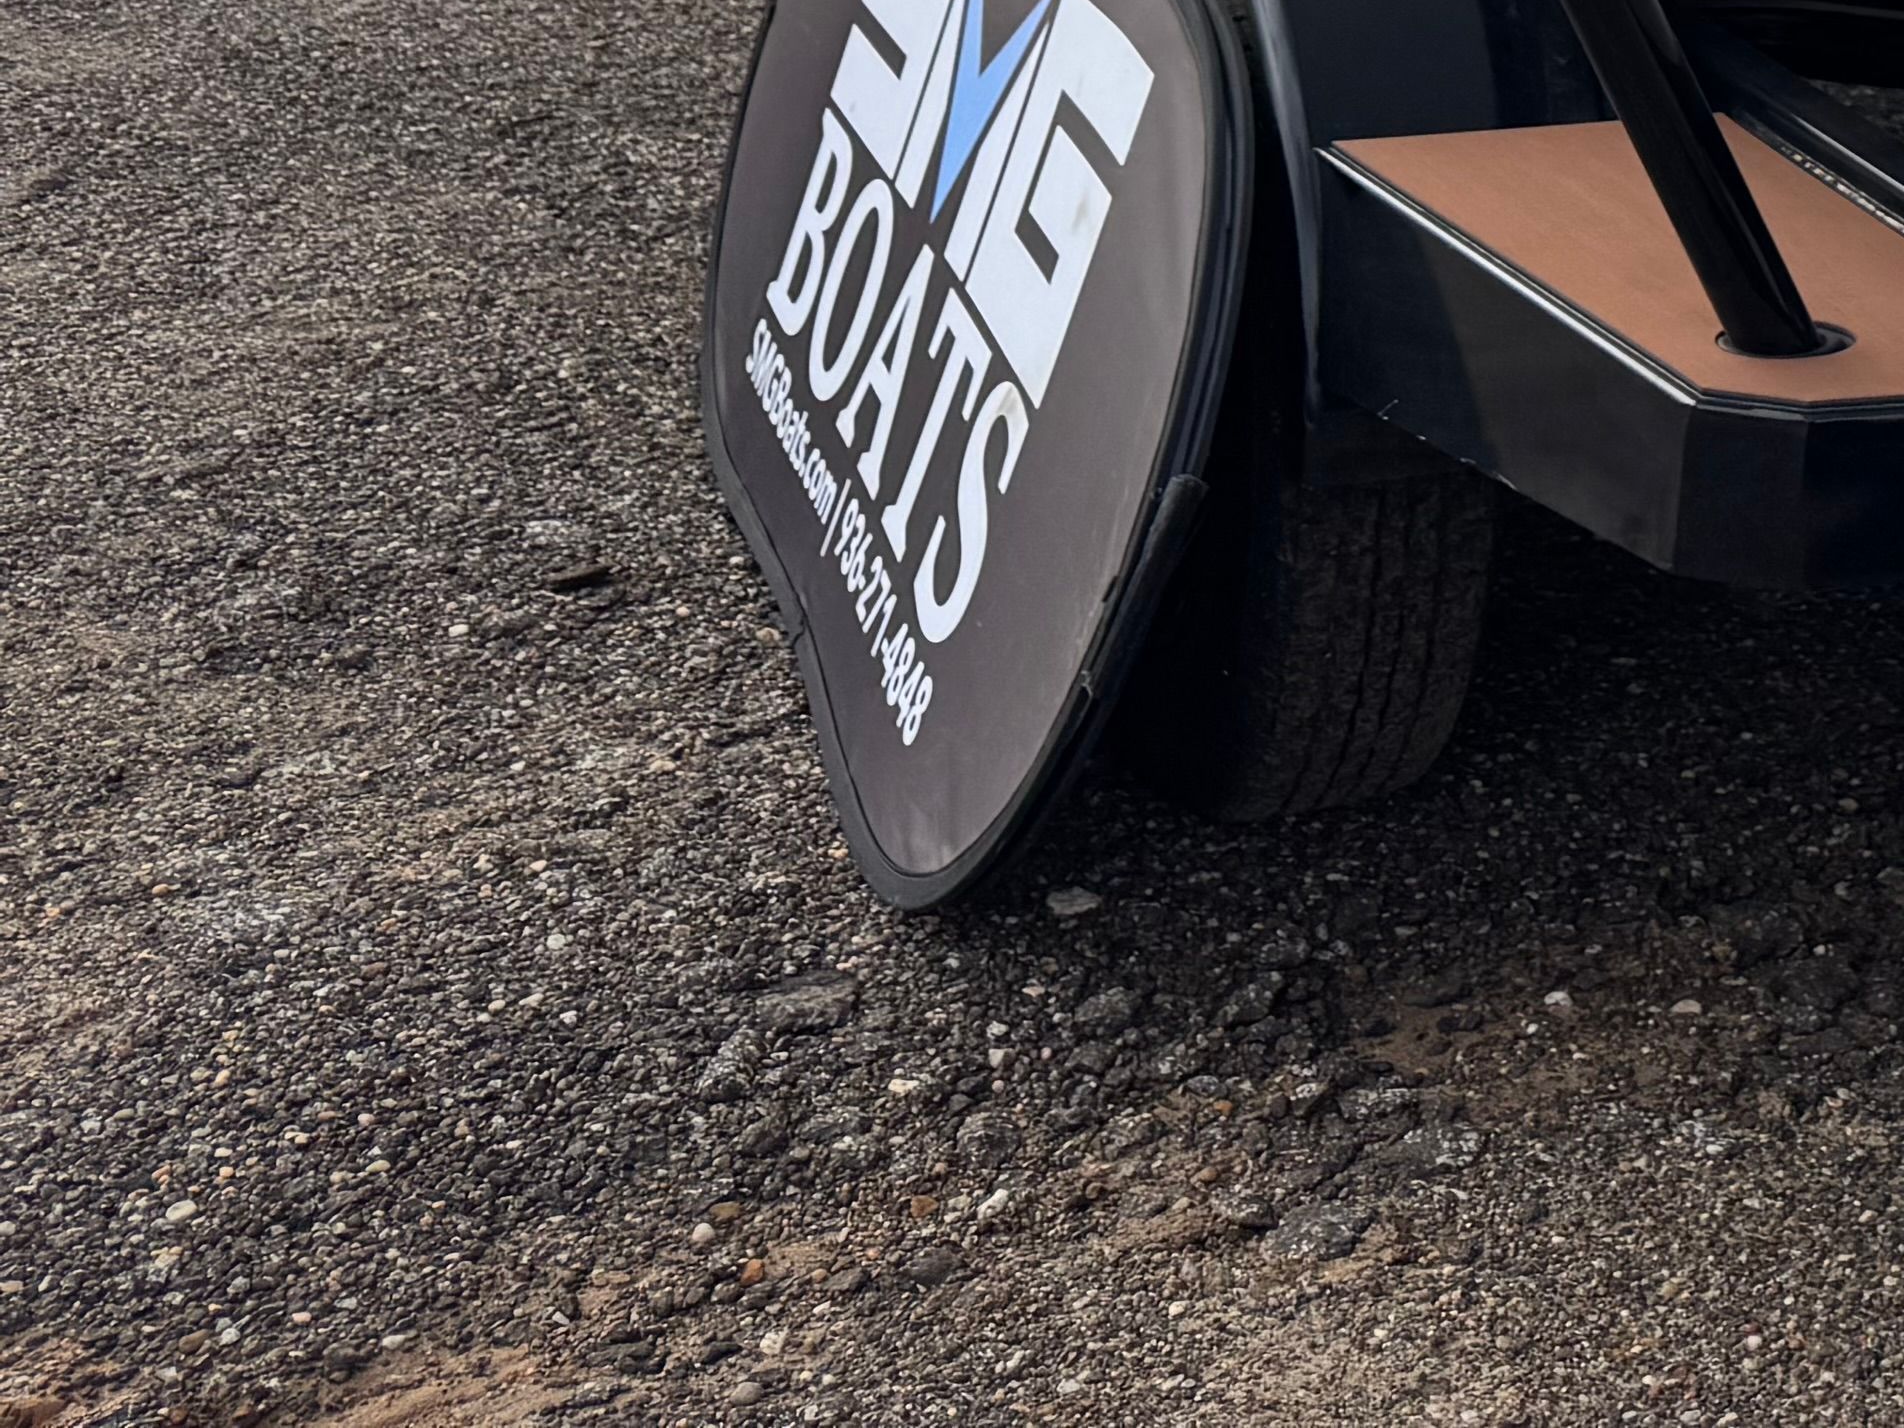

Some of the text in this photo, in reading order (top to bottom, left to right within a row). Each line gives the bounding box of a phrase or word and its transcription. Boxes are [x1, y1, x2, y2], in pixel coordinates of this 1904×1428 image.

[746, 318, 838, 525] SMGBoats.com
[834, 498, 933, 746] 936-271-4848
[766, 107, 1029, 644] BOATS
